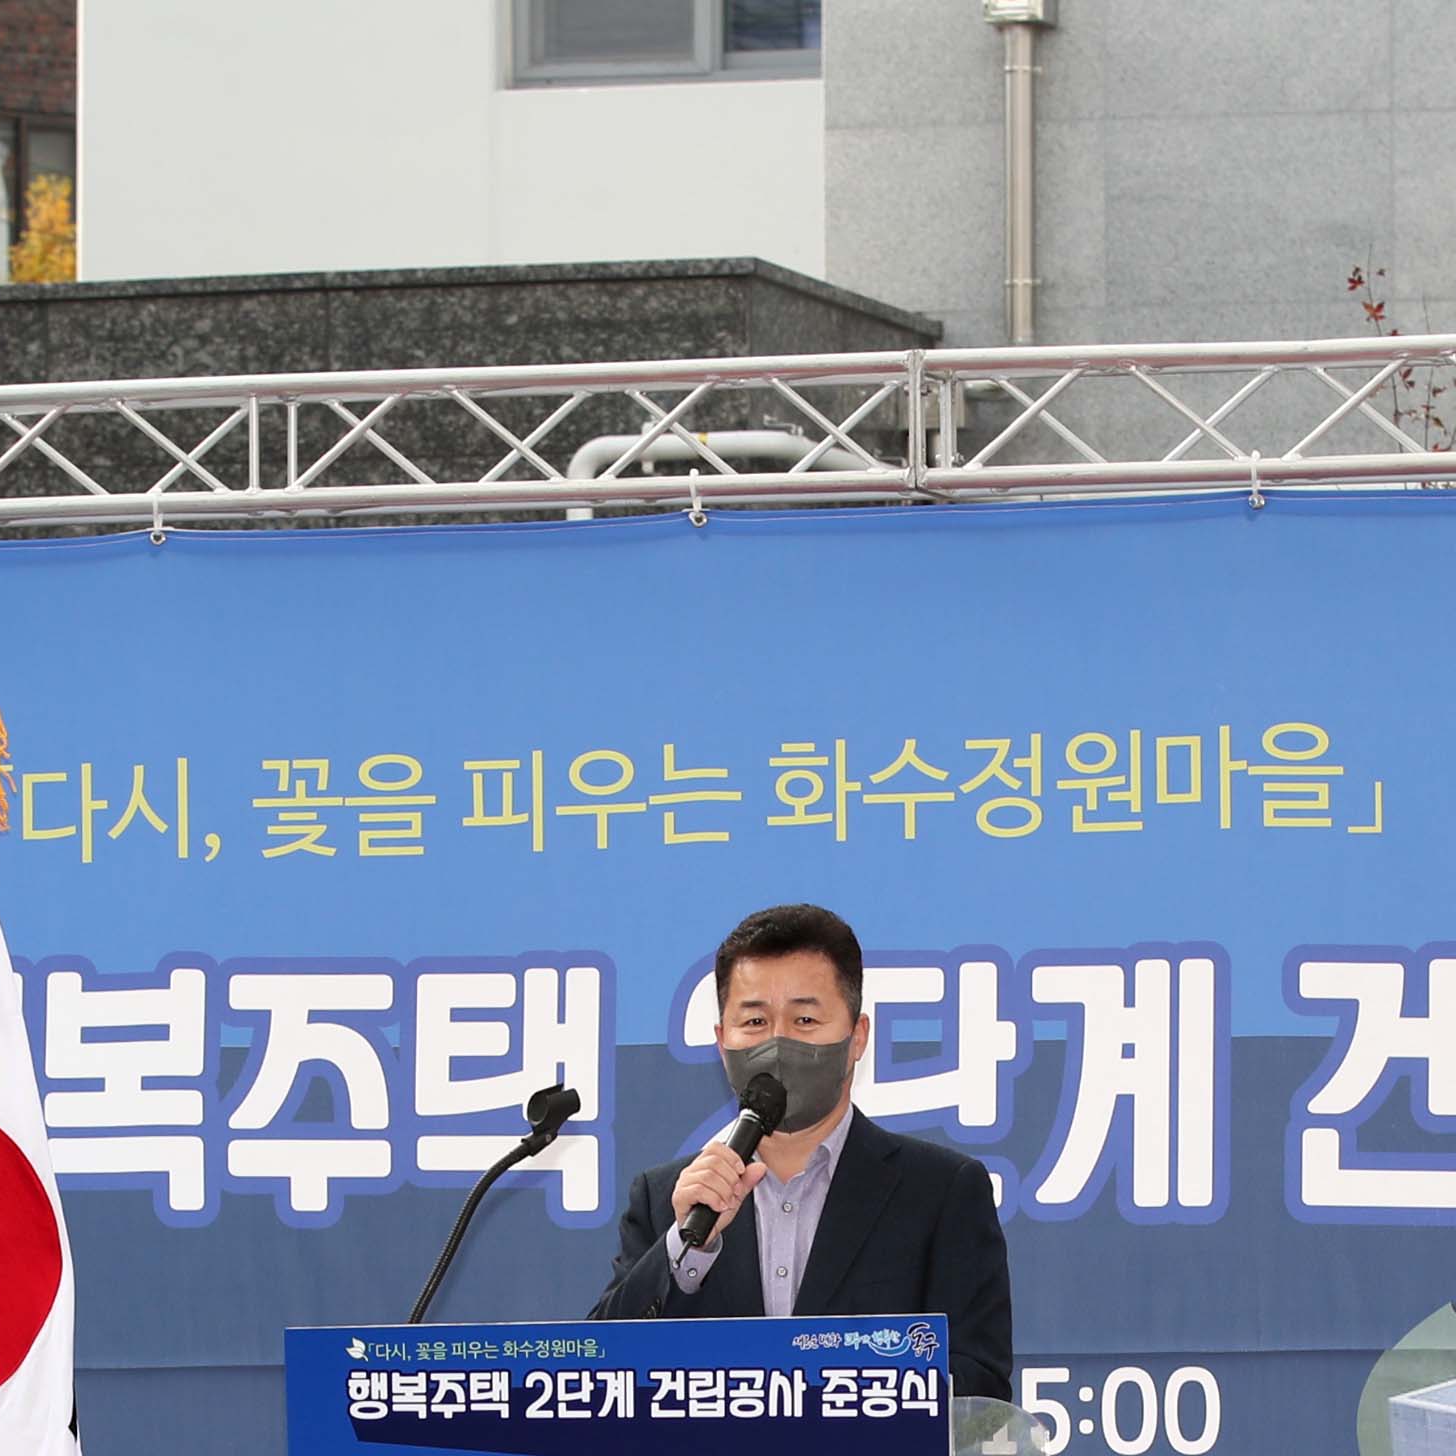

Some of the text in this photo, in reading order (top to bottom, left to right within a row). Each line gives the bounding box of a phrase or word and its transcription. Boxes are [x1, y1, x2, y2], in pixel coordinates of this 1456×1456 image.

[252, 753, 437, 859] 꽃을
[462, 743, 742, 852] 피우는
[767, 721, 1383, 842] 화수정원마을」
[12, 965, 601, 1213] 복주택
[347, 1368, 940, 1420] 행복주택 2단계 건립공사 준공식
[415, 1342, 448, 1361] 꽃을
[451, 1340, 500, 1360] 피우는
